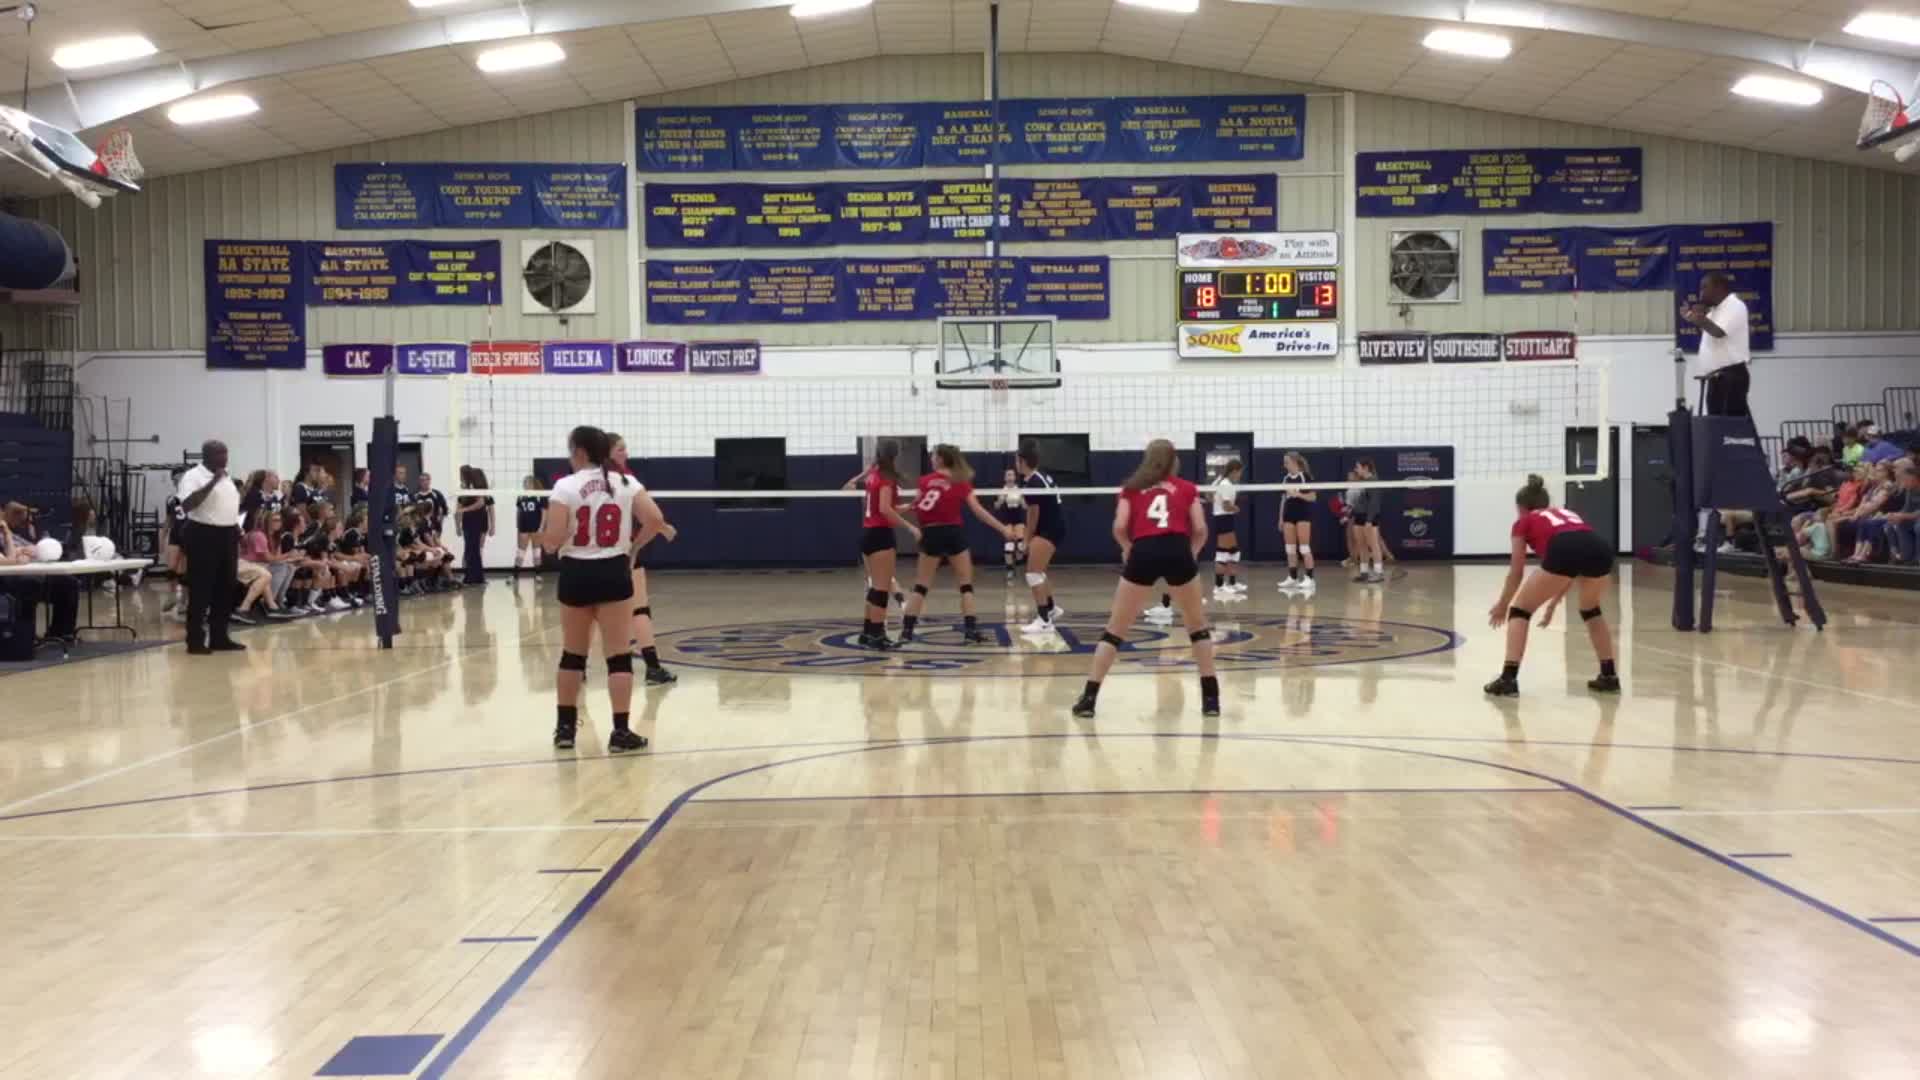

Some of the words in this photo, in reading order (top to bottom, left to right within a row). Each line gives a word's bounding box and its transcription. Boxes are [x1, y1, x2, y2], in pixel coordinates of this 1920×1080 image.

[944, 110, 993, 119] BASEBAL
[1249, 116, 1296, 127] NORTH
[1059, 121, 1105, 132] CHAMPS
[455, 196, 511, 206] CHAMPS
[763, 193, 816, 203] SOFTBALL
[217, 245, 291, 257] BASKETBALL
[324, 247, 385, 257] BASKETBALL
[217, 258, 238, 273] AA
[242, 257, 290, 272] STATE
[320, 260, 339, 272] AA
[344, 258, 390, 272] STATE
[1184, 273, 1213, 283] HOME
[1246, 272, 1292, 294] 1:00
[1298, 271, 1336, 282] VISITOR
[1196, 286, 1217, 308] 18
[1314, 284, 1335, 306] 13
[1237, 305, 1264, 313] PERIOD
[1272, 301, 1279, 319] 1
[1187, 334, 1242, 348] SONIC
[1248, 327, 1311, 340] America's
[1276, 340, 1332, 352] Drive-In
[1359, 340, 1426, 358] RIVERVIEW
[1432, 339, 1498, 357] SOUTHSIDE
[1505, 338, 1570, 355] STUTTGART
[345, 351, 371, 368] CAC
[408, 350, 457, 369] E-STEM
[471, 352, 500, 367] HEBER
[503, 351, 539, 367] SPRINGS
[553, 350, 604, 367] HELENA
[626, 349, 675, 366] LONOKE
[692, 350, 730, 367] BAPTIST
[732, 350, 758, 365] PREP
[919, 489, 941, 511] 8
[1146, 495, 1170, 529] 4
[573, 502, 622, 547] 18
[369, 554, 388, 616] SPALDING
